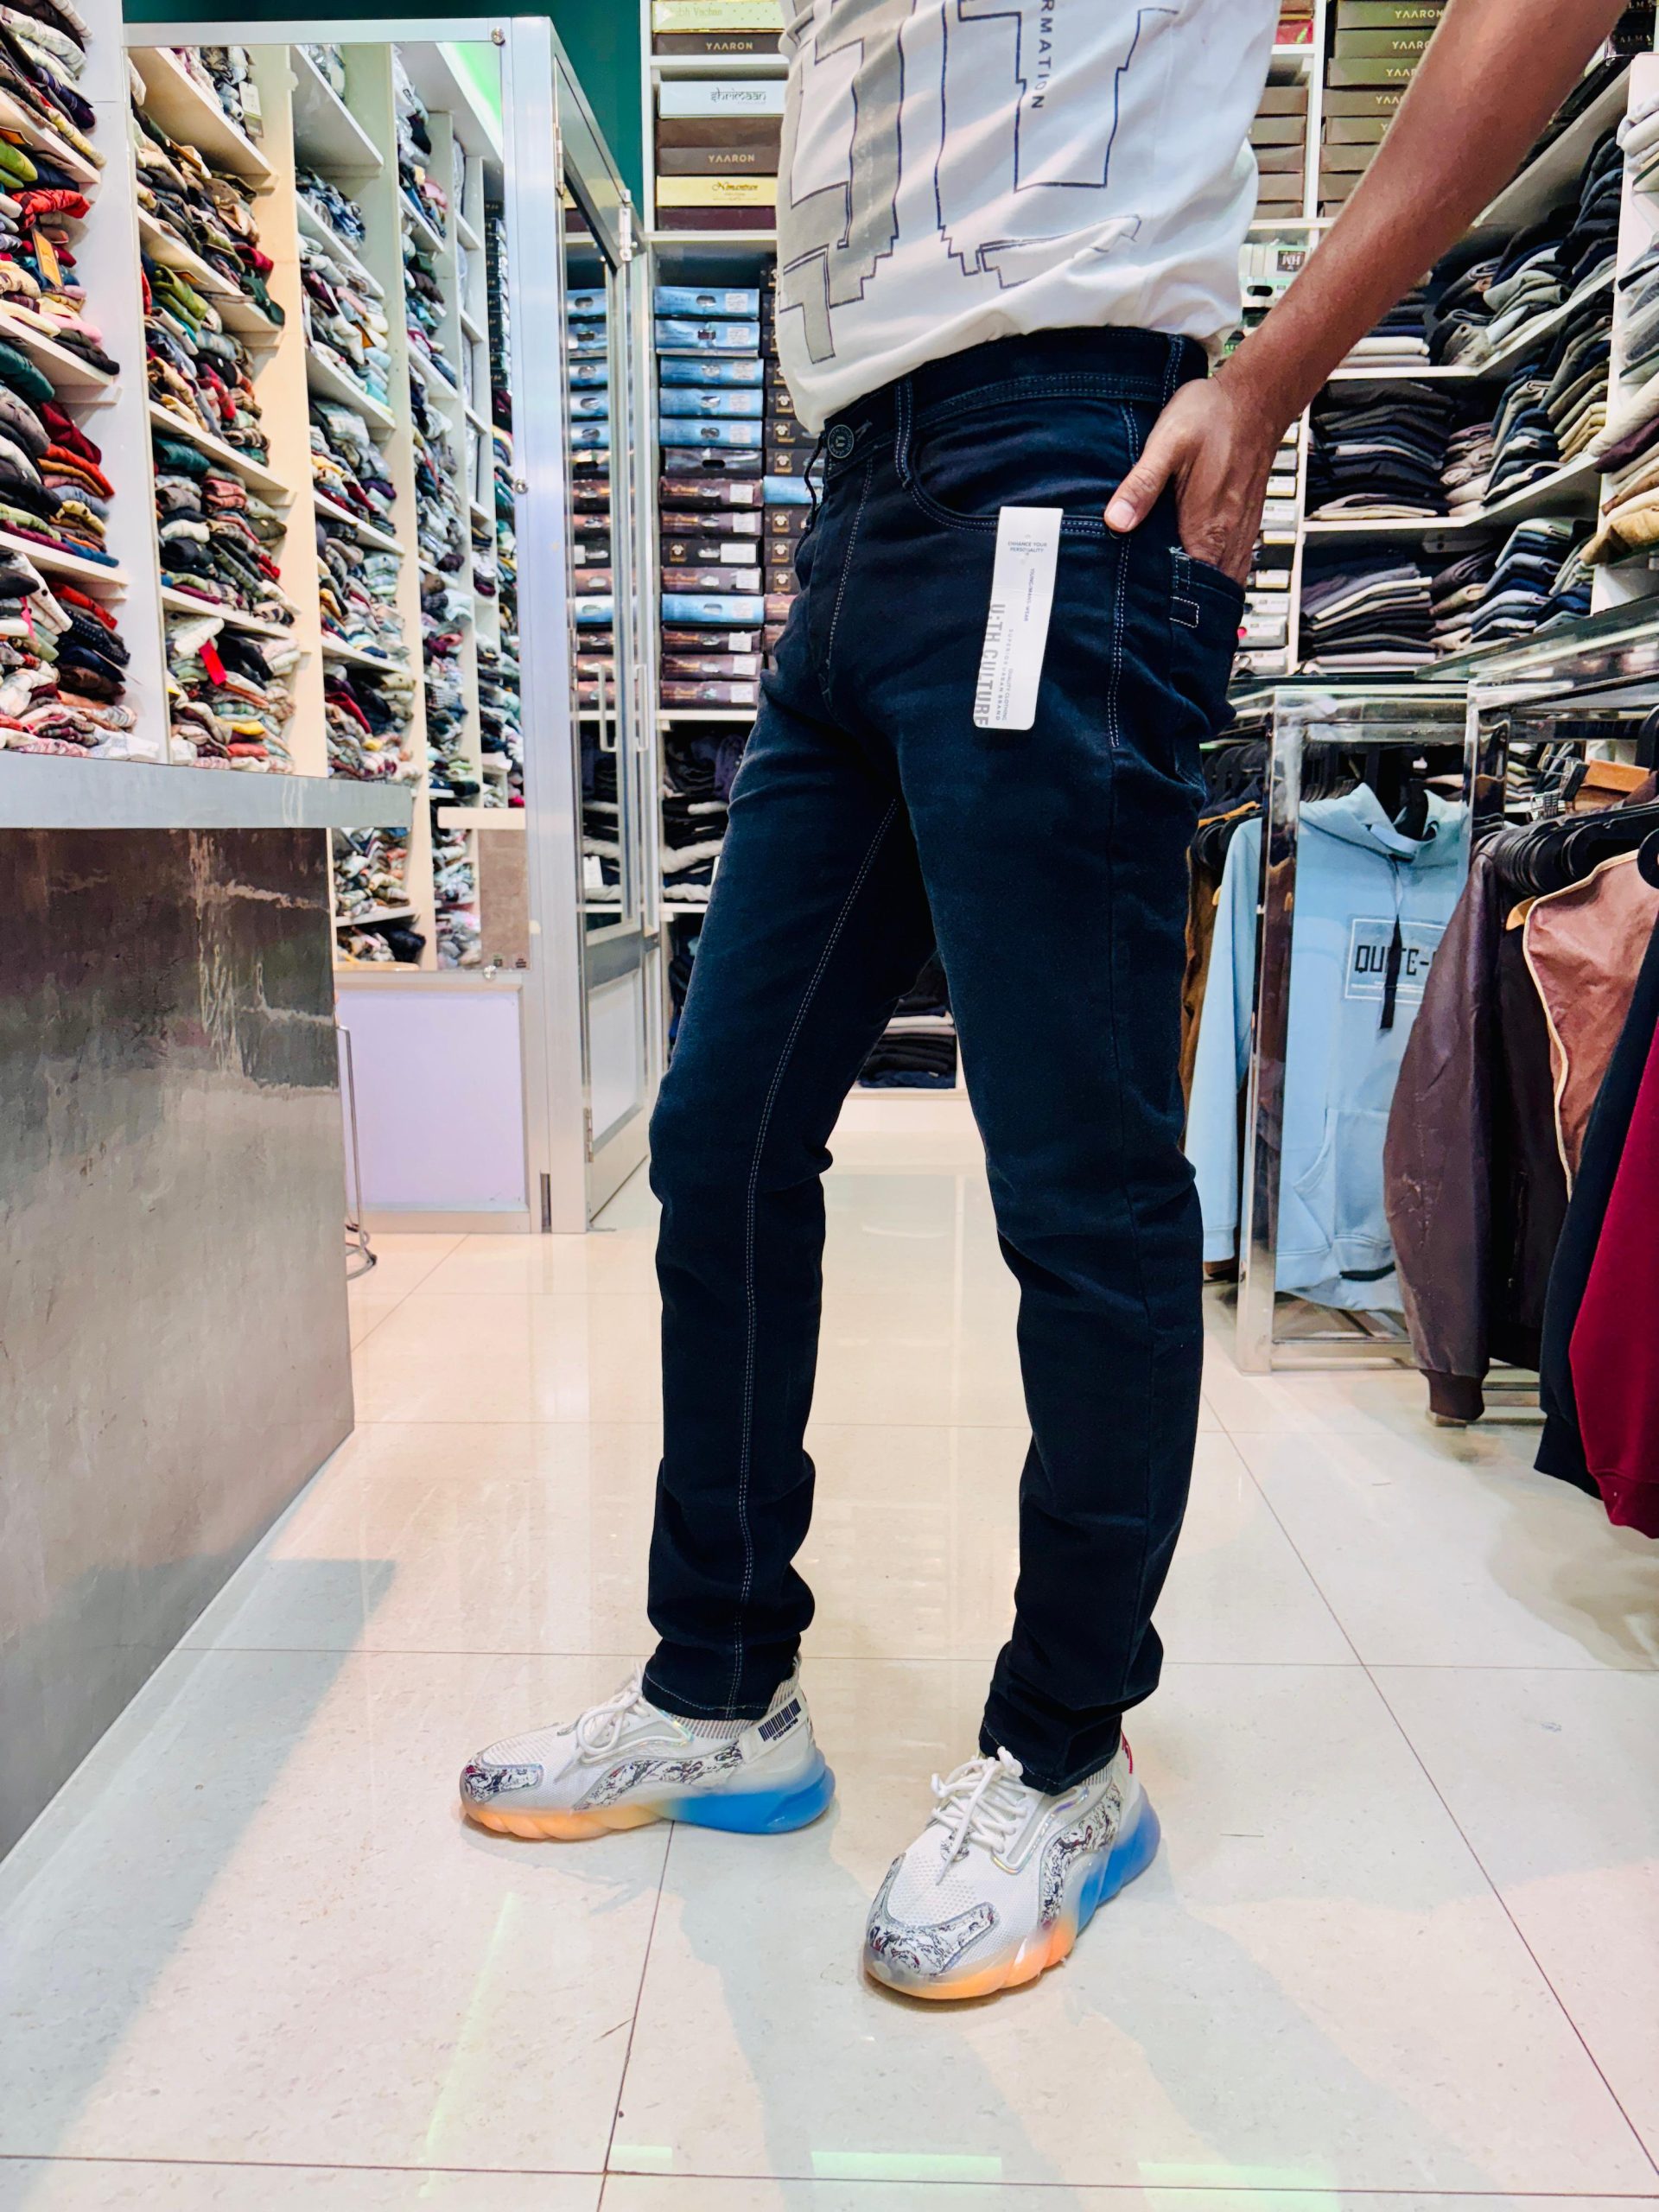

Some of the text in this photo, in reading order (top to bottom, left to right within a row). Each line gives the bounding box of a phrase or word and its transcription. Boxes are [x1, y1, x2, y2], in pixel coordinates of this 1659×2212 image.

[705, 41, 753, 50] YAARON
[708, 154, 755, 162] YAARON
[973, 649, 999, 726] CULTURE
